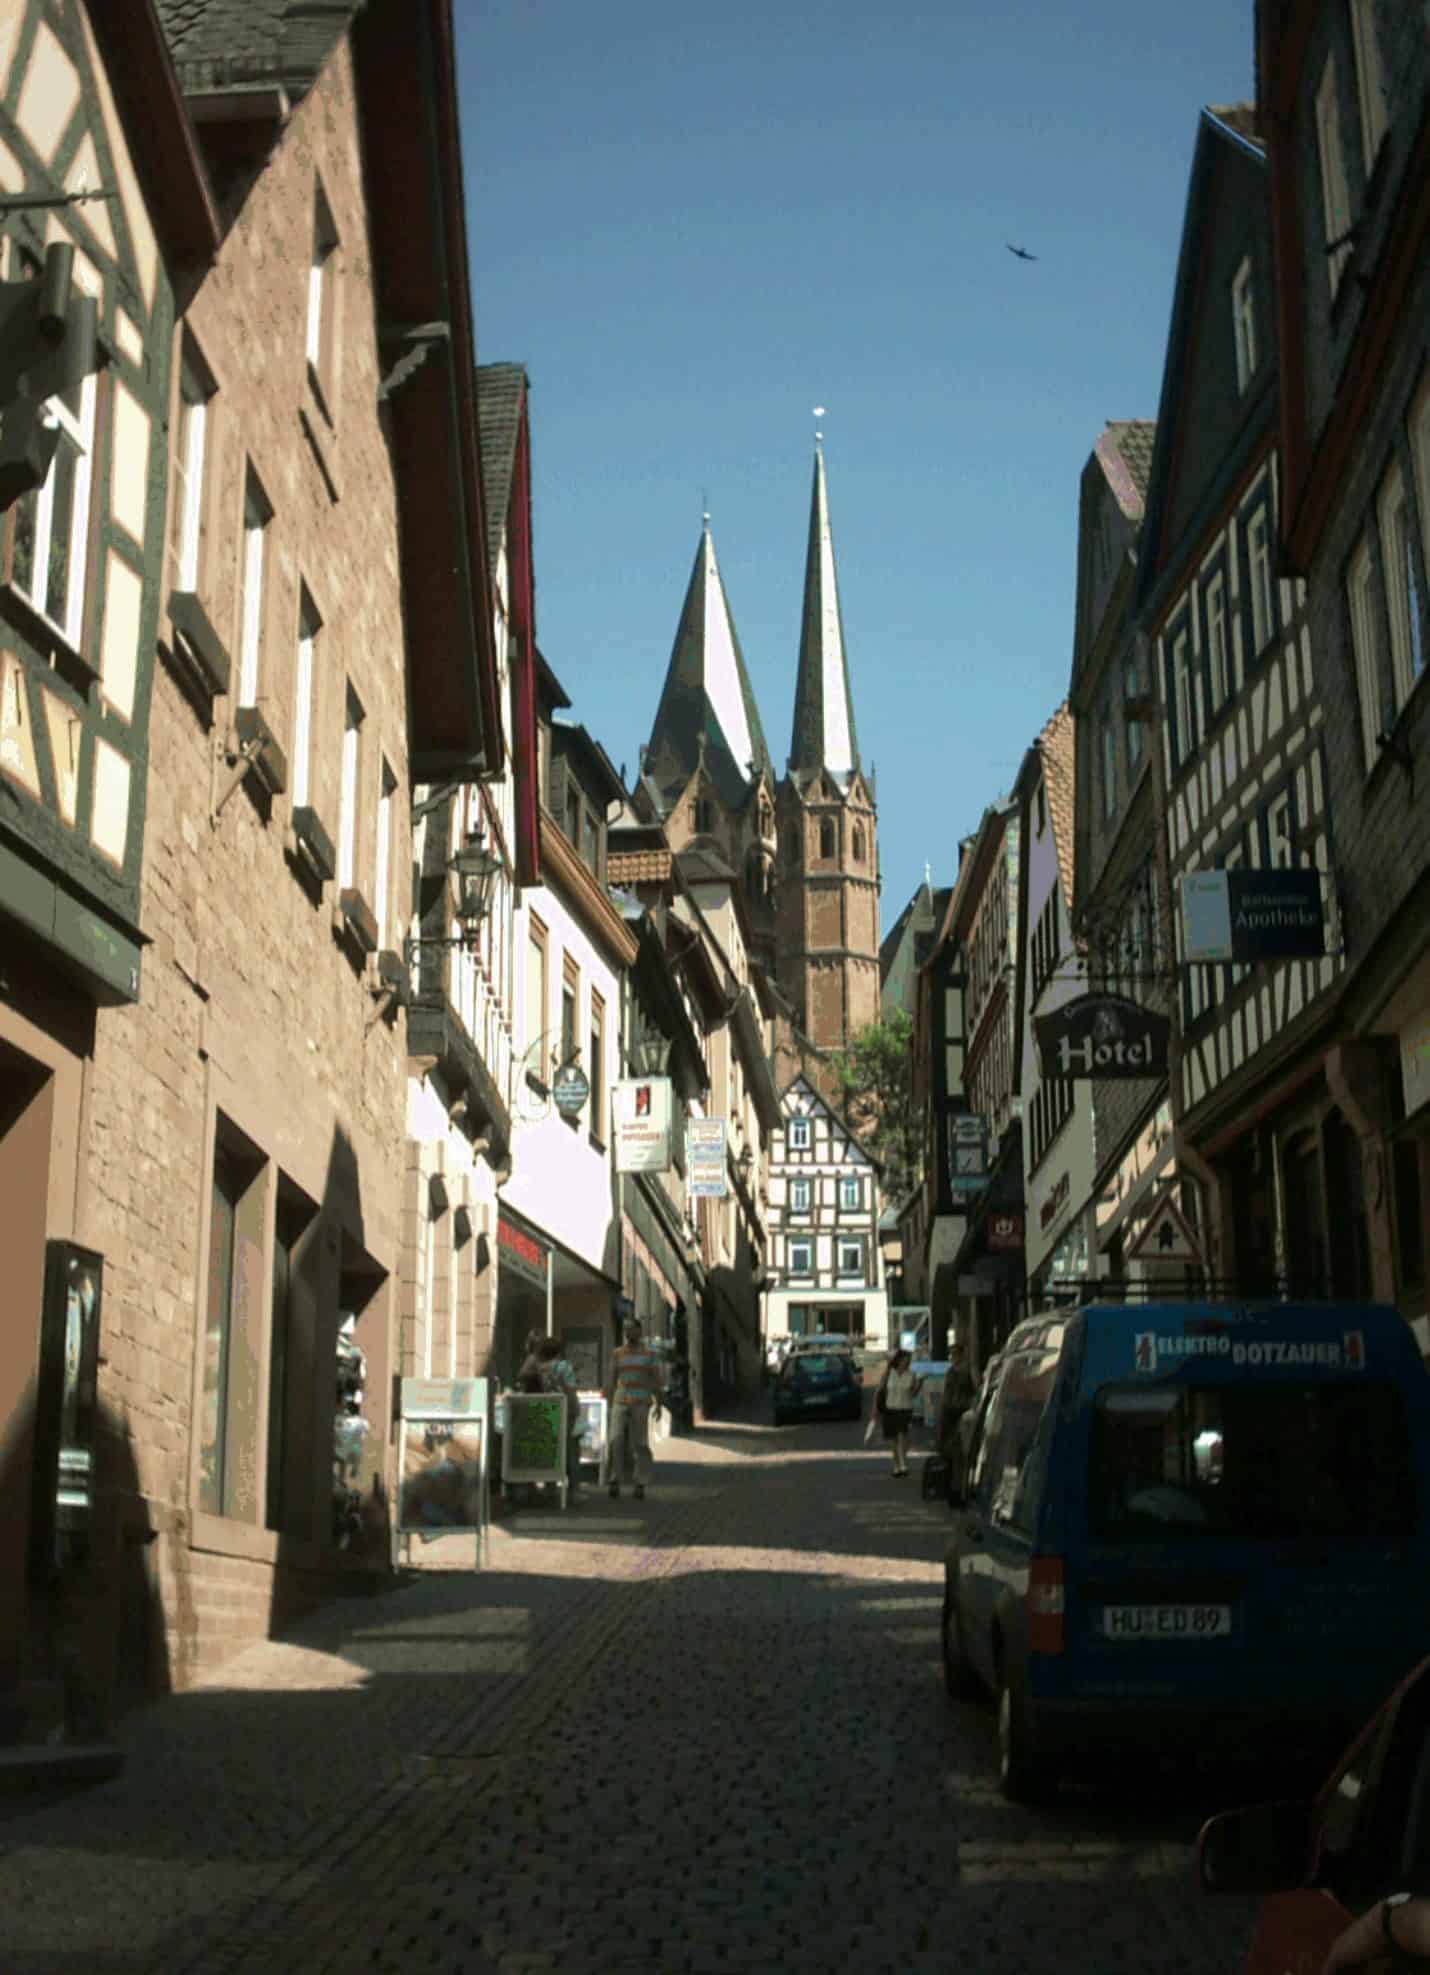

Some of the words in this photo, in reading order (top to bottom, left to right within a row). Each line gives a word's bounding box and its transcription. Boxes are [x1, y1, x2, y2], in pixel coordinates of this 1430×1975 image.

[1234, 906, 1317, 928] Apotheke
[1057, 1033, 1153, 1073] Hotel
[1157, 1335, 1231, 1355] ELEKTRO
